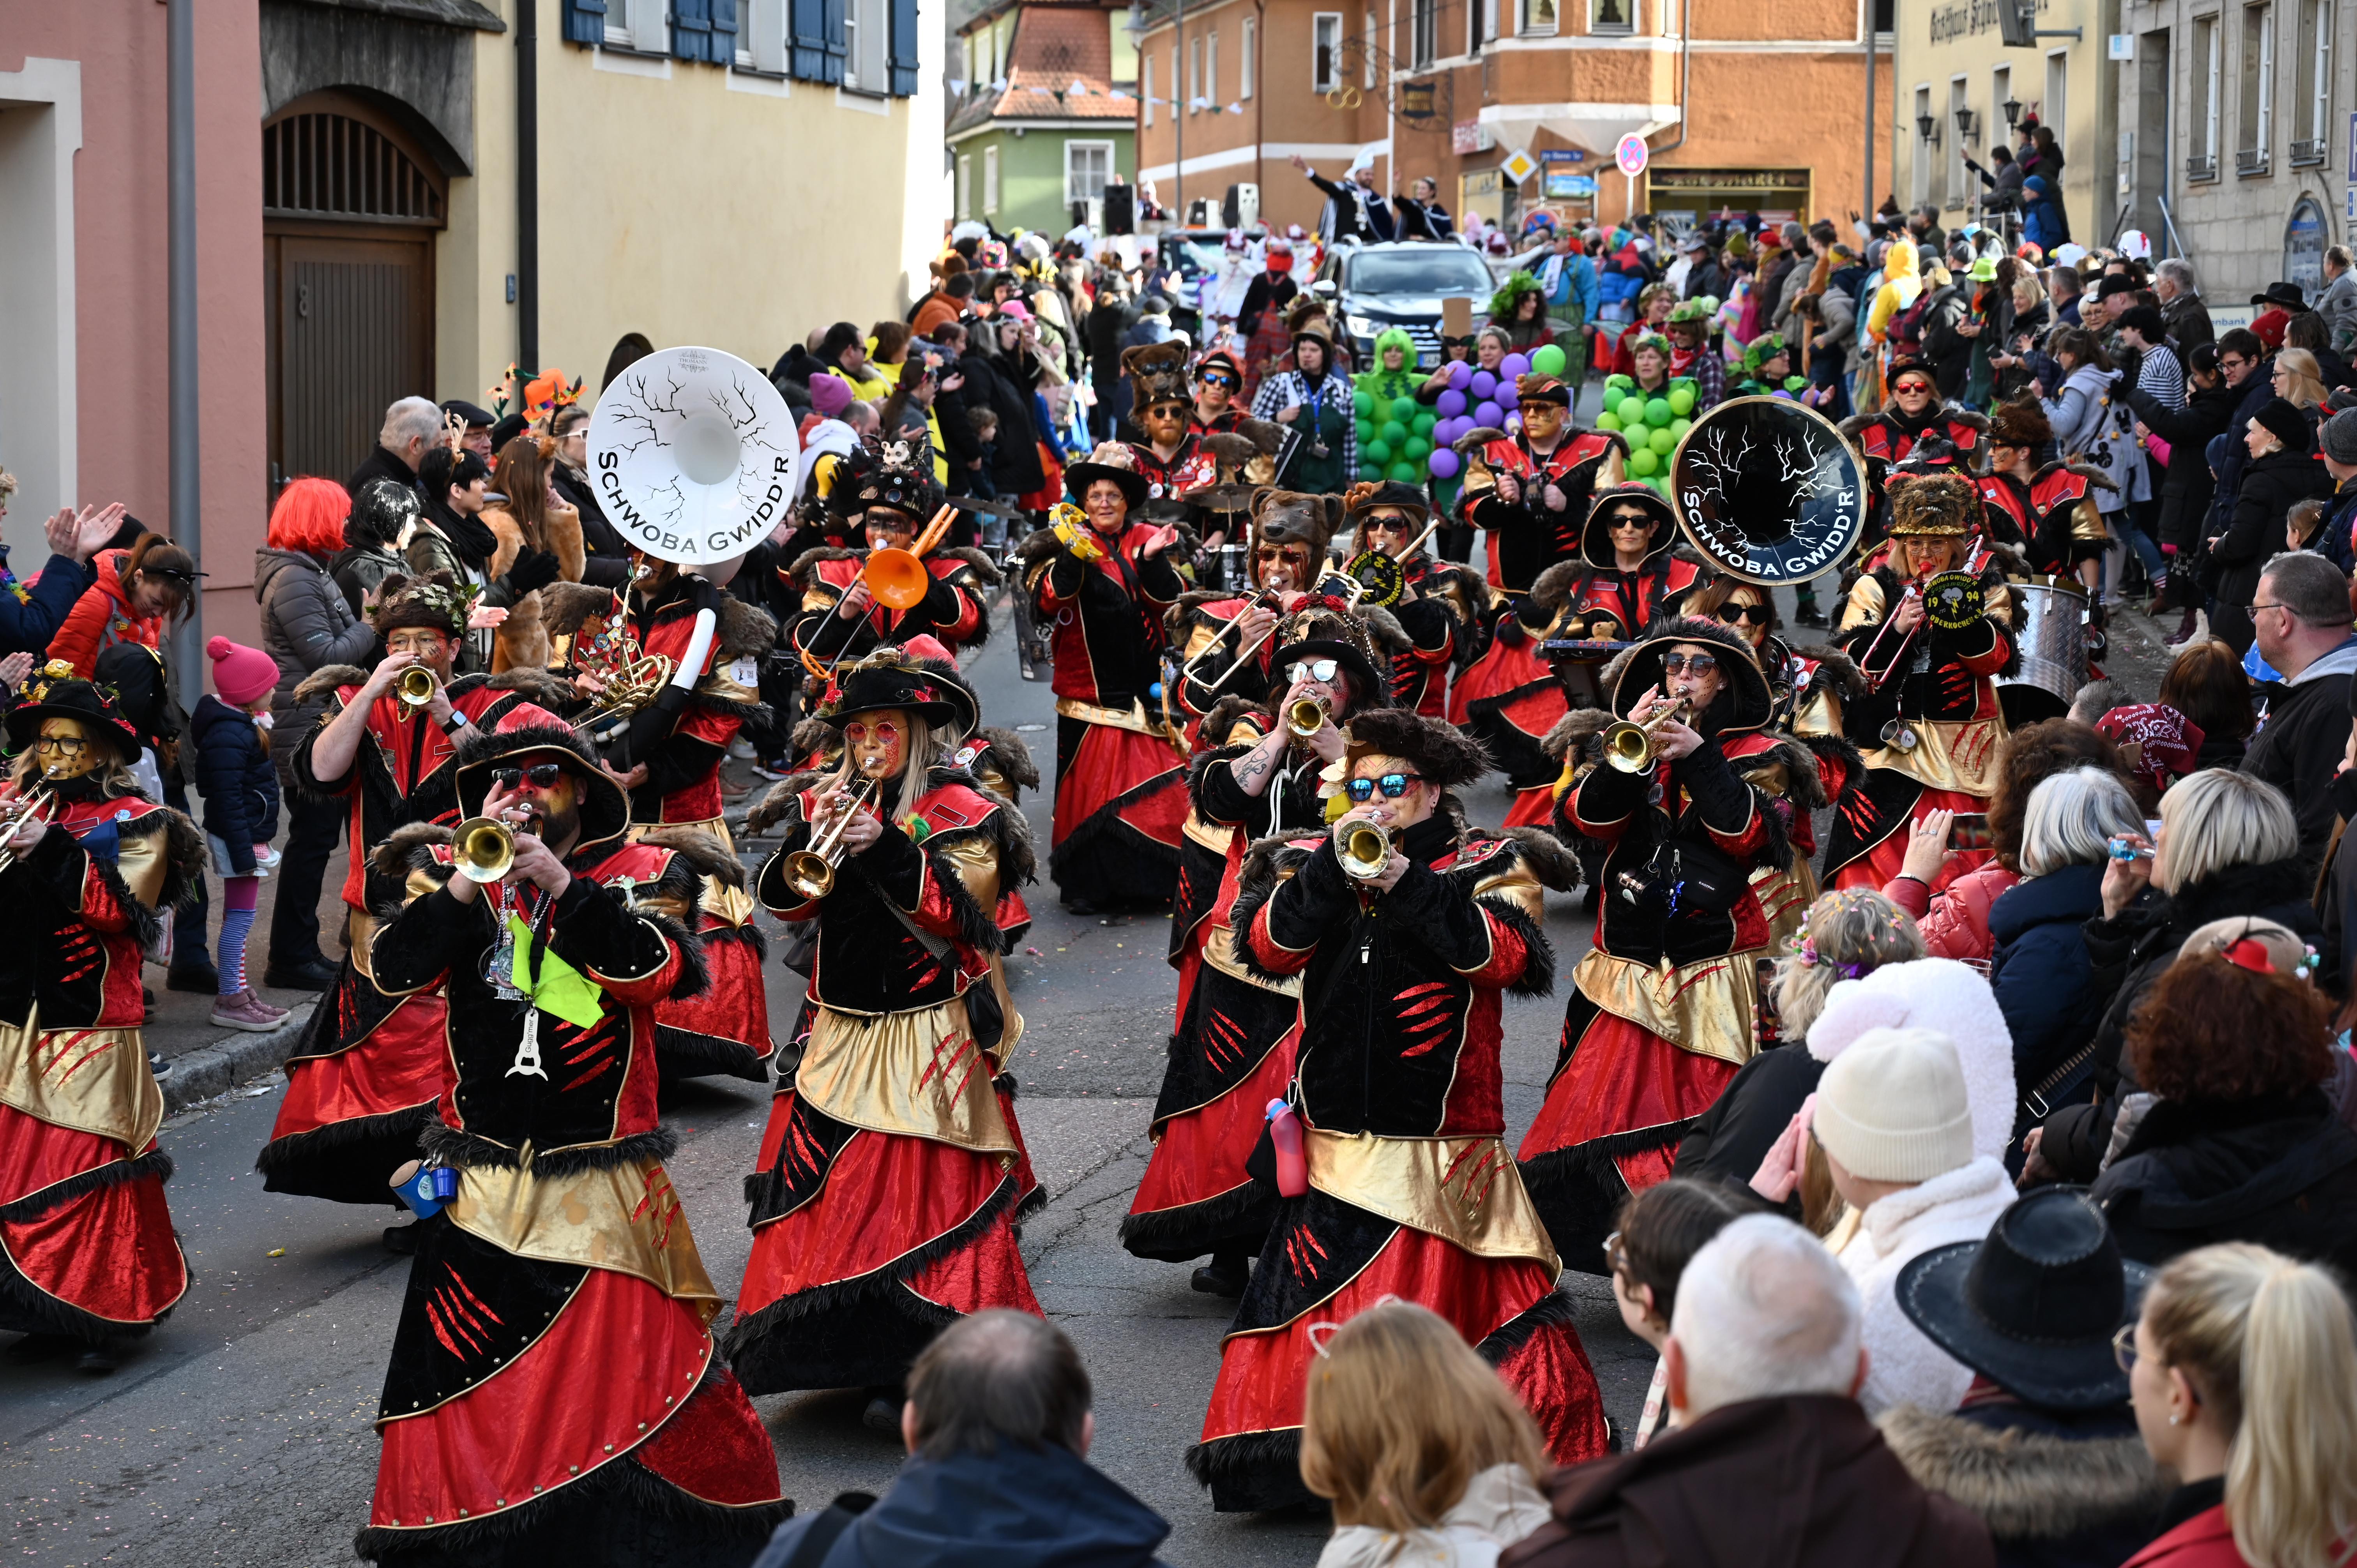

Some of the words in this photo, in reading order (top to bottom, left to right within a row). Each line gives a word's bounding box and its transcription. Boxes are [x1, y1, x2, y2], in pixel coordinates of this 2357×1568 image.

[598, 452, 697, 554] SCHWOBA
[1684, 491, 1780, 576] SCHWOBA
[1374, 556, 1387, 569] 94
[1928, 597, 1938, 607] 19
[1966, 591, 1979, 602] 94
[1930, 614, 1975, 629] OBERKOCHEN
[1341, 823, 1362, 844] Schwoba
[1698, 881, 1716, 891] EASTPAK
[525, 1019, 534, 1052] Gugg'mer
